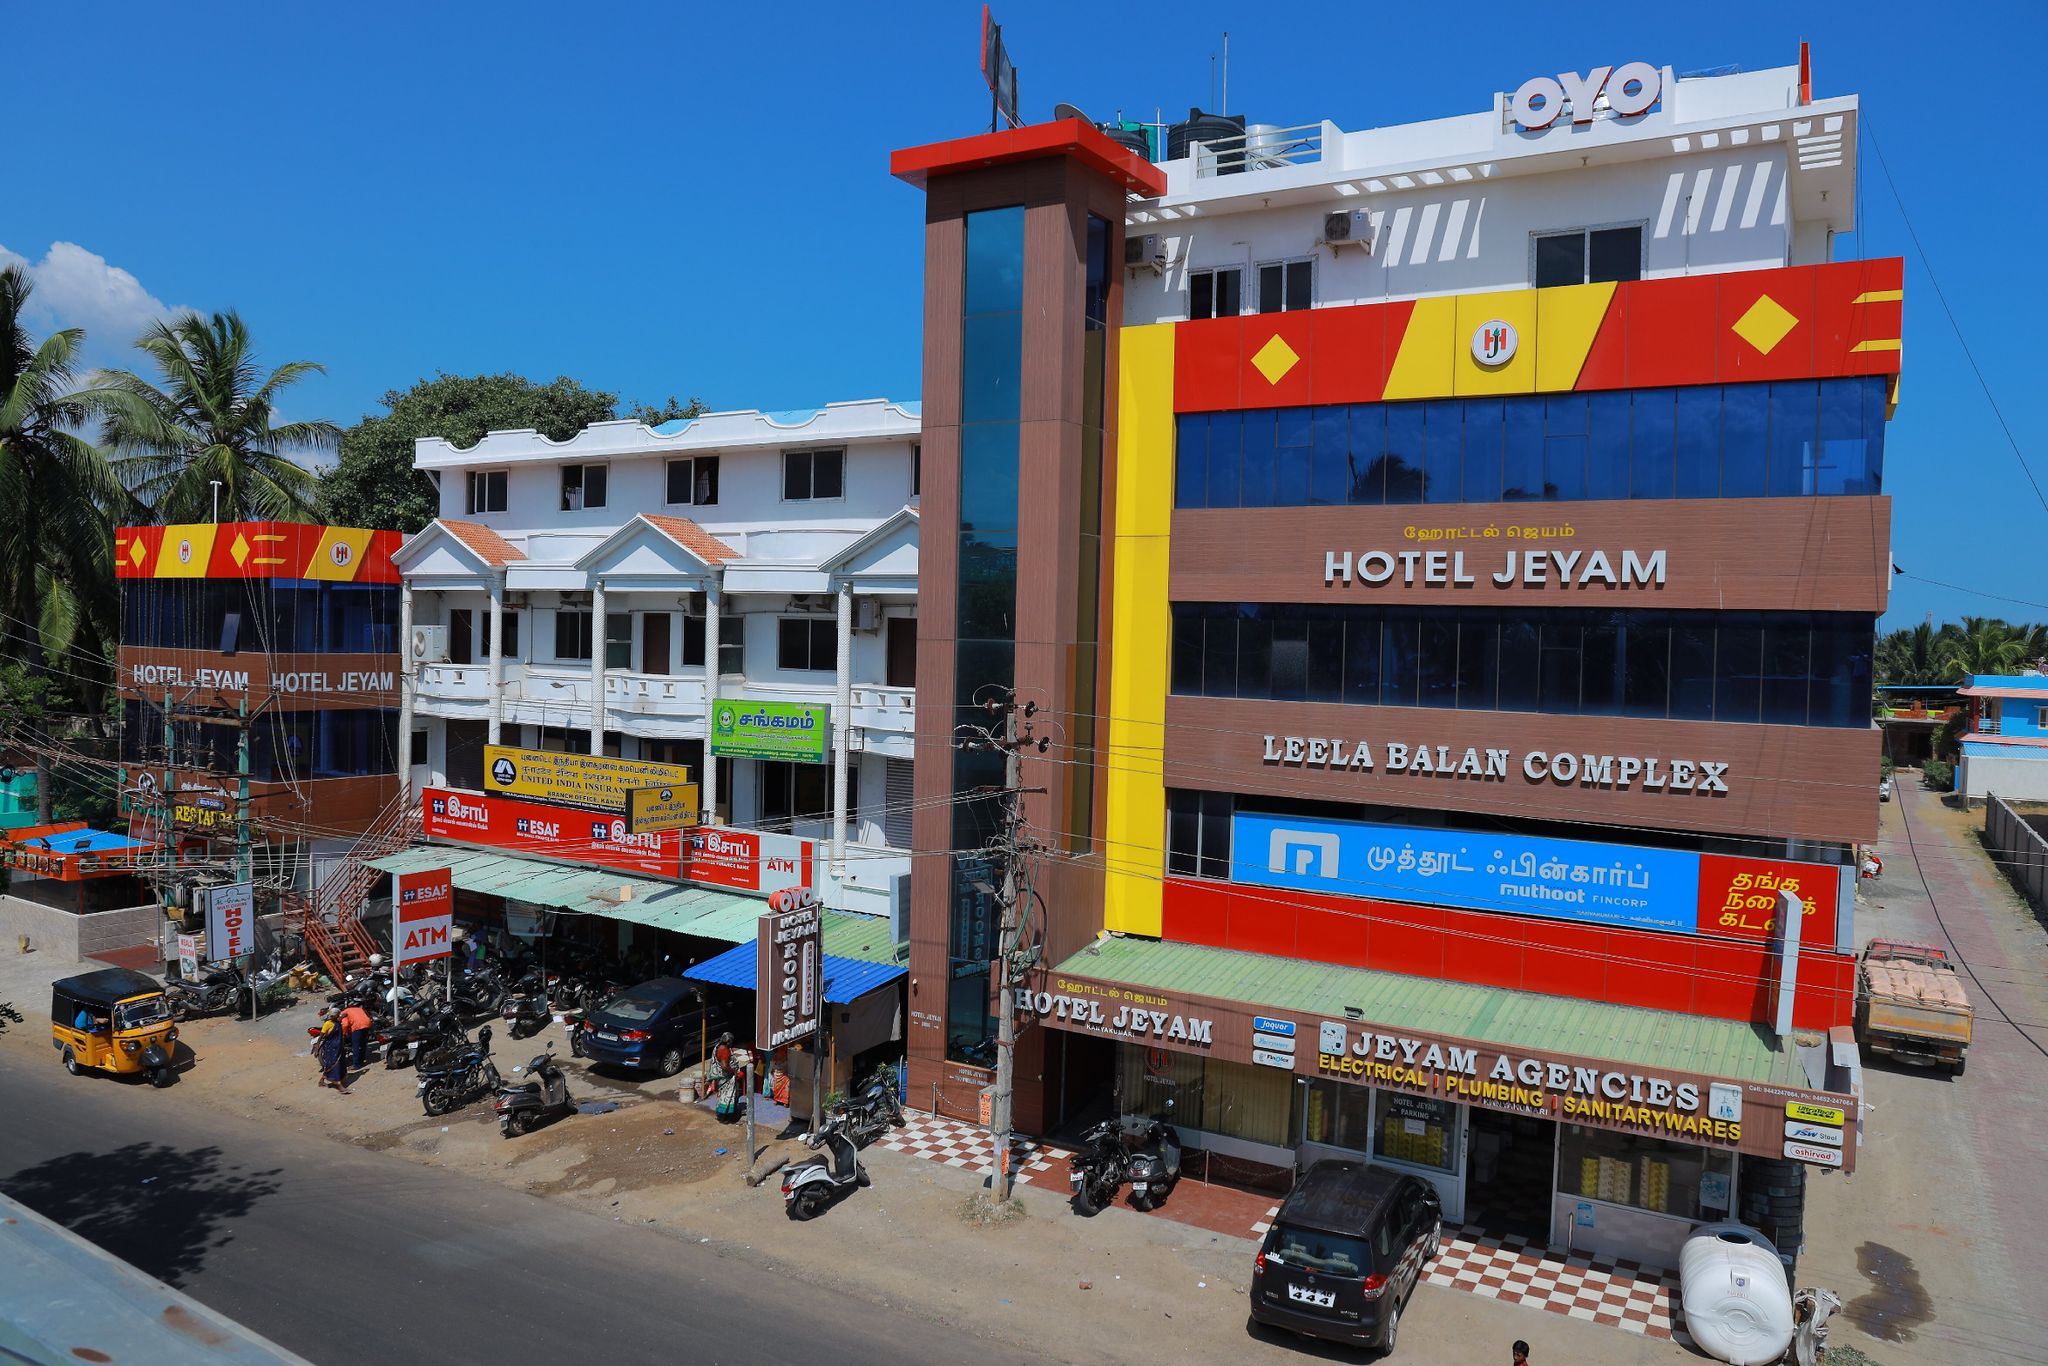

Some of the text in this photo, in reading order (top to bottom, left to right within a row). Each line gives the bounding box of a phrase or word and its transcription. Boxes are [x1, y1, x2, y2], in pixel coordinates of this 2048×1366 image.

[1511, 62, 1661, 130] OYO
[1404, 523, 1574, 542] ஹோட்டல் ஜெயம்
[1325, 550, 1667, 583] HOTEL JEYAM
[133, 665, 249, 690] HOTEL JEYAM
[272, 672, 393, 693] HOTEL JEYAM
[739, 709, 814, 729] சங்கமம்
[1263, 736, 1730, 791] LEELA BALAN COMPLEX
[521, 775, 553, 786] UNITED
[556, 779, 582, 789] INDIA
[585, 783, 626, 794] INSURAN
[547, 790, 573, 800] BRANCH
[447, 795, 489, 823] இசாப்
[530, 819, 560, 837] ESAF
[708, 832, 750, 857] இசாப்
[767, 858, 795, 873] ATM
[1367, 845, 1649, 890] முத்தூட் ஃபின்கார்ப்
[417, 884, 448, 900] ESAF
[1728, 871, 1800, 893] தங்க
[775, 887, 813, 912] OYO
[1500, 883, 1649, 908] muthoot FINCORP
[780, 911, 815, 929] HOTEL
[224, 907, 243, 957] HOTEL
[404, 925, 447, 950] ATM
[775, 921, 817, 943] JEYAM
[782, 942, 798, 1026] ROOMS
[1057, 979, 1167, 1006] ஹோட்டல் ஜெயம்
[1014, 987, 1213, 1044] HOTEL JEYAM
[1261, 1019, 1288, 1031] Jaquar
[1086, 1023, 1135, 1038] KANYAKUMARI
[1352, 1032, 1700, 1111] JEYAM AGENCIES
[1319, 1054, 1741, 1141] ELECTRICAL PLUMBING SANITARYWARES
[1393, 1097, 1437, 1111] HOTEL JEYAM
[1400, 1108, 1430, 1119] PARKING
[1797, 1105, 1836, 1116] UltraTech
[1792, 1129, 1837, 1141] JSW Steel
[1795, 1149, 1831, 1159] ashirvad
